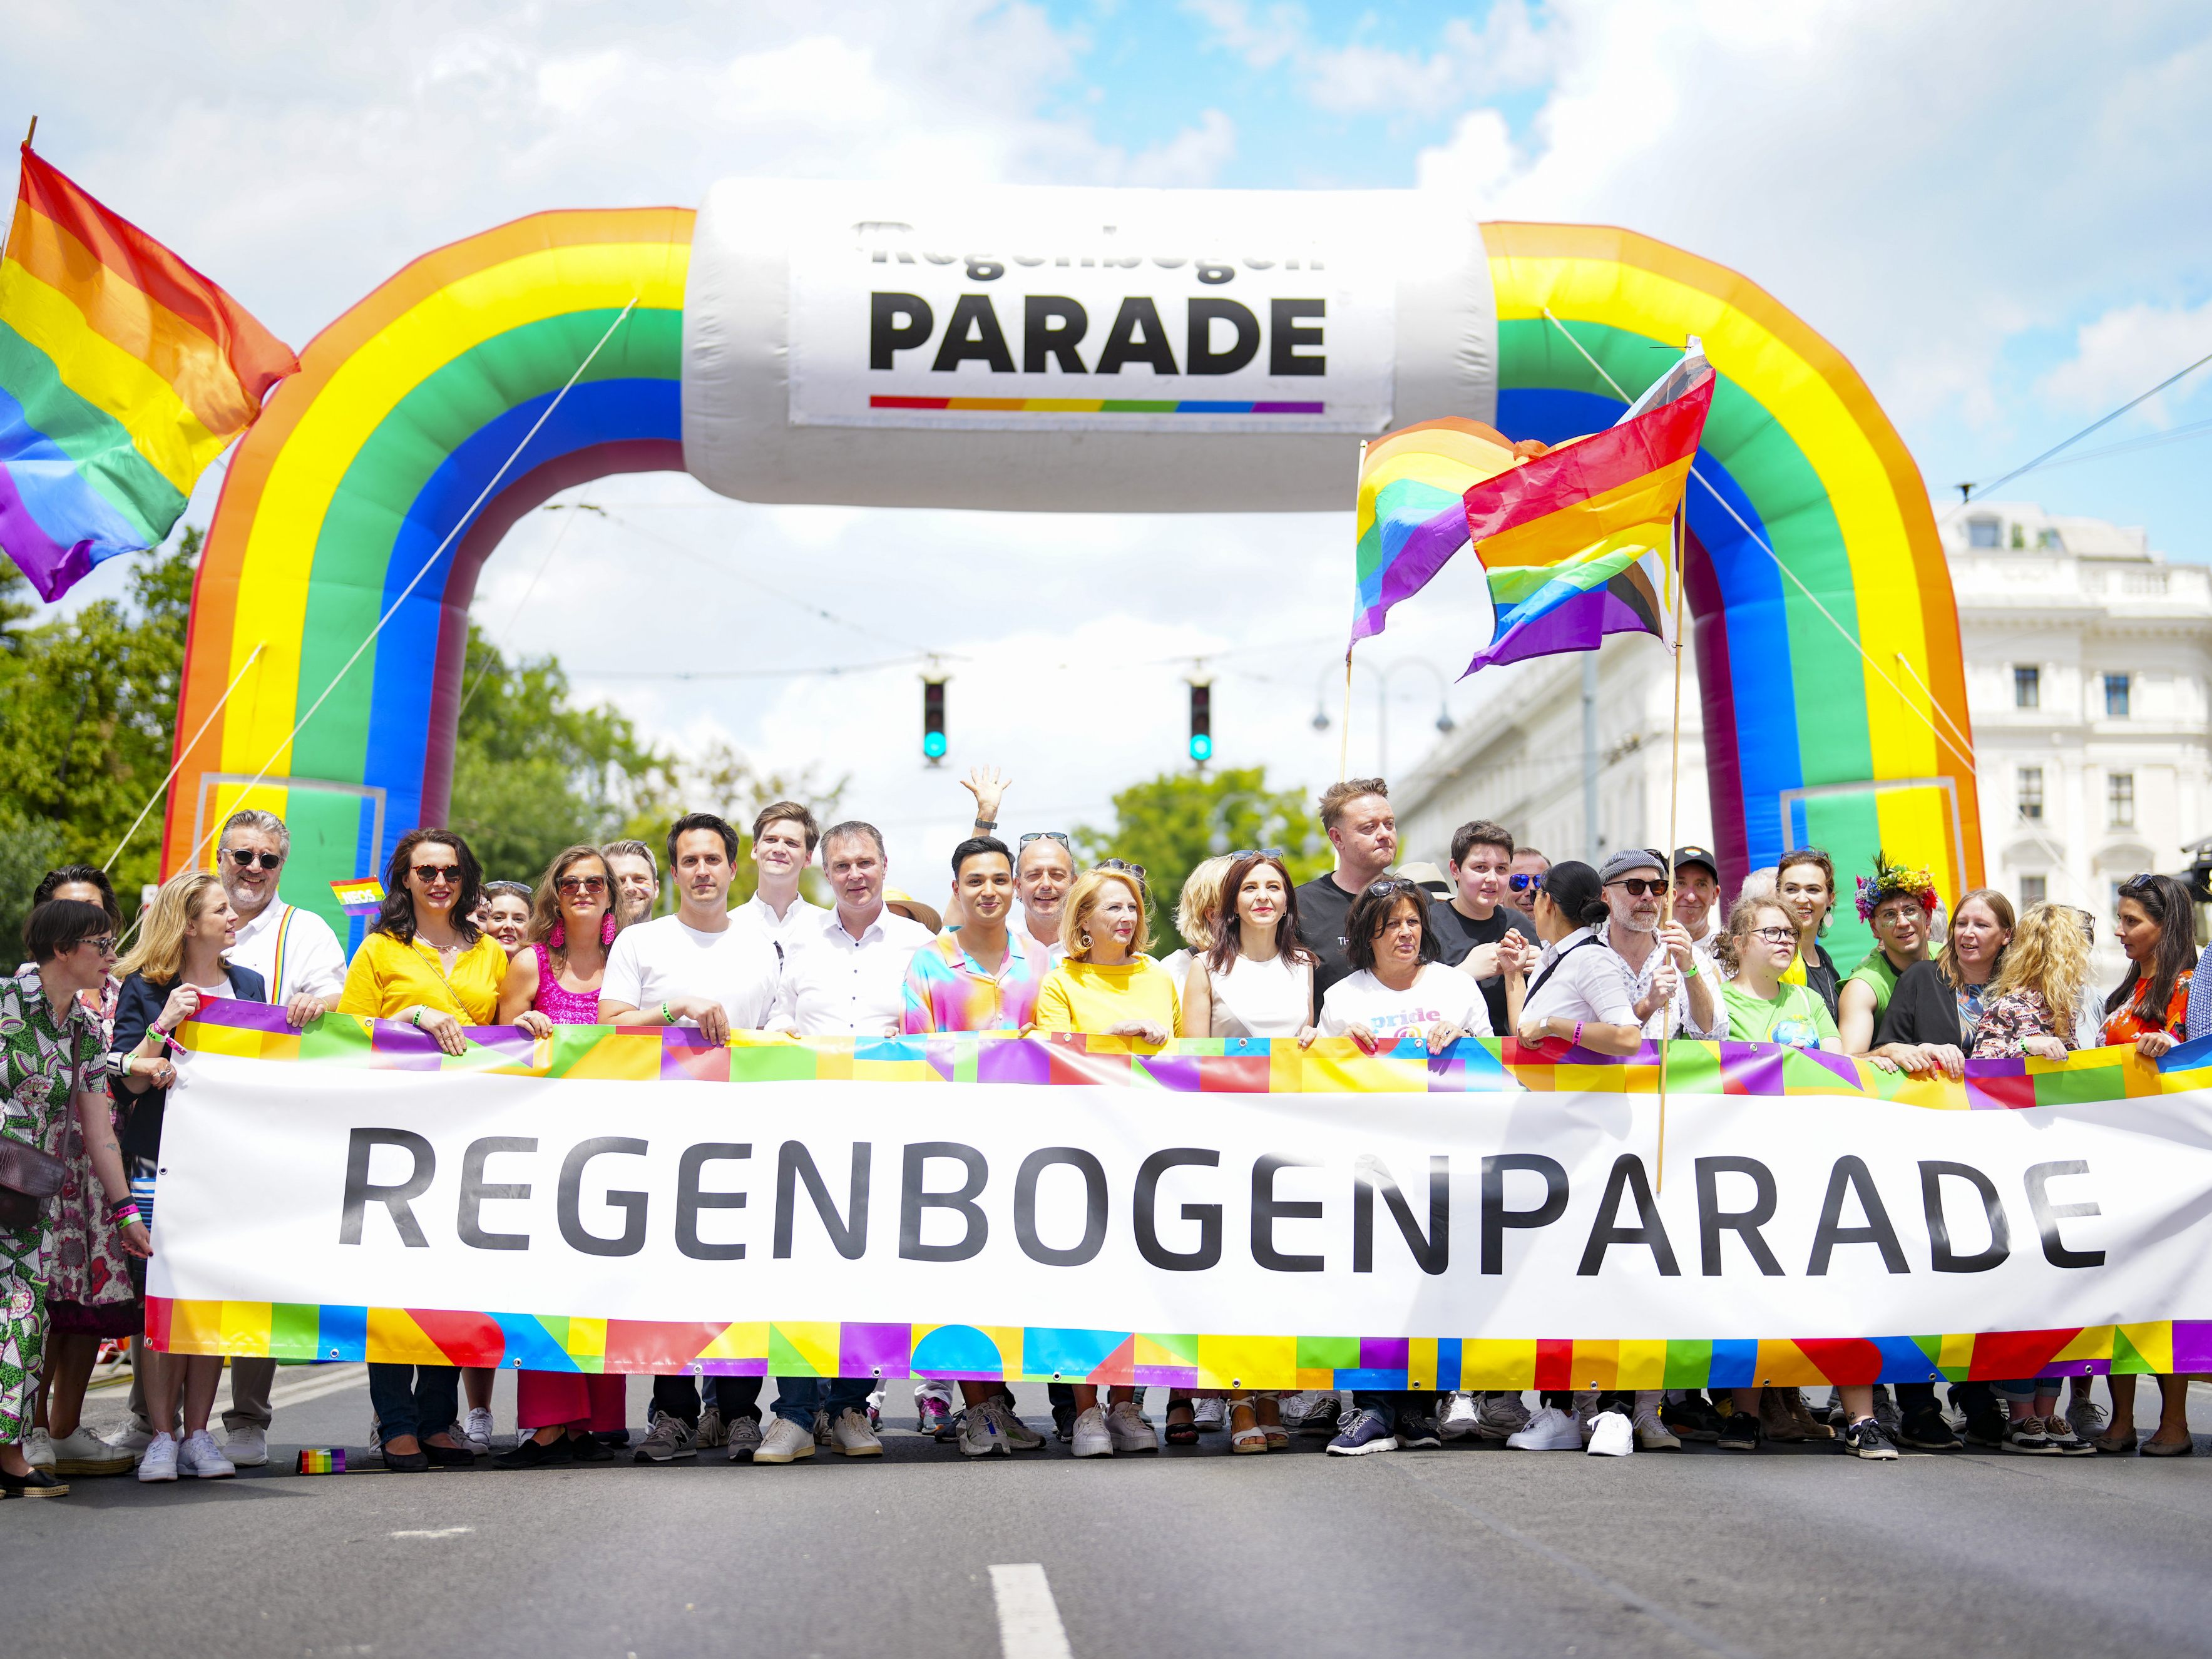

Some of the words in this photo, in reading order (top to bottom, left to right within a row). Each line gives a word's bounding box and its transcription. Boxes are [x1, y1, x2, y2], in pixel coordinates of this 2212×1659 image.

[870, 293, 1325, 375] PARADE
[341, 889, 376, 905] NEOS
[1371, 1007, 1441, 1034] pride
[339, 1128, 2106, 1276] REGENBOGENPARADE
